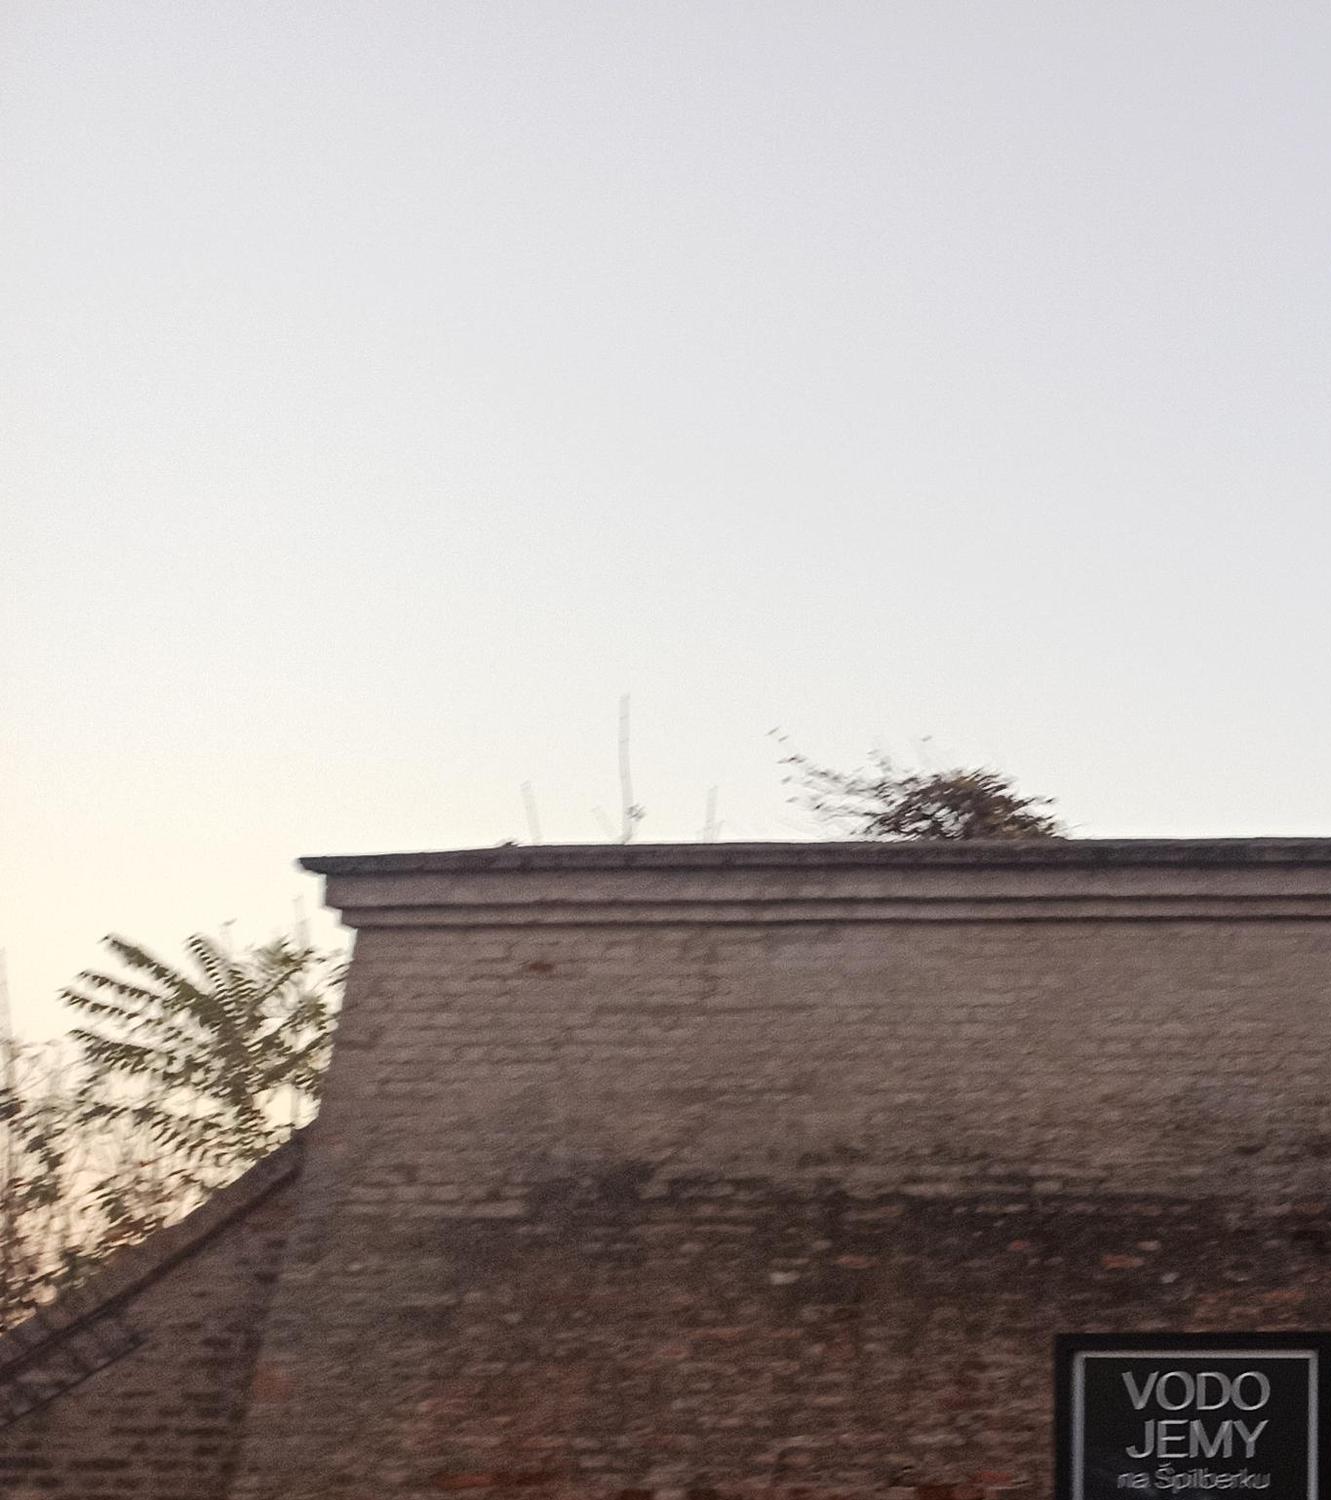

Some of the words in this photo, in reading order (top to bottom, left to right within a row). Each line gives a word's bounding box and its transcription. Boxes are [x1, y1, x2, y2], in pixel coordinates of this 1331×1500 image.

[1121, 1370, 1271, 1411] VODO
[1125, 1419, 1269, 1460] JEMY
[1117, 1473, 1150, 1488] na
[1154, 1462, 1271, 1494] Špilberku
